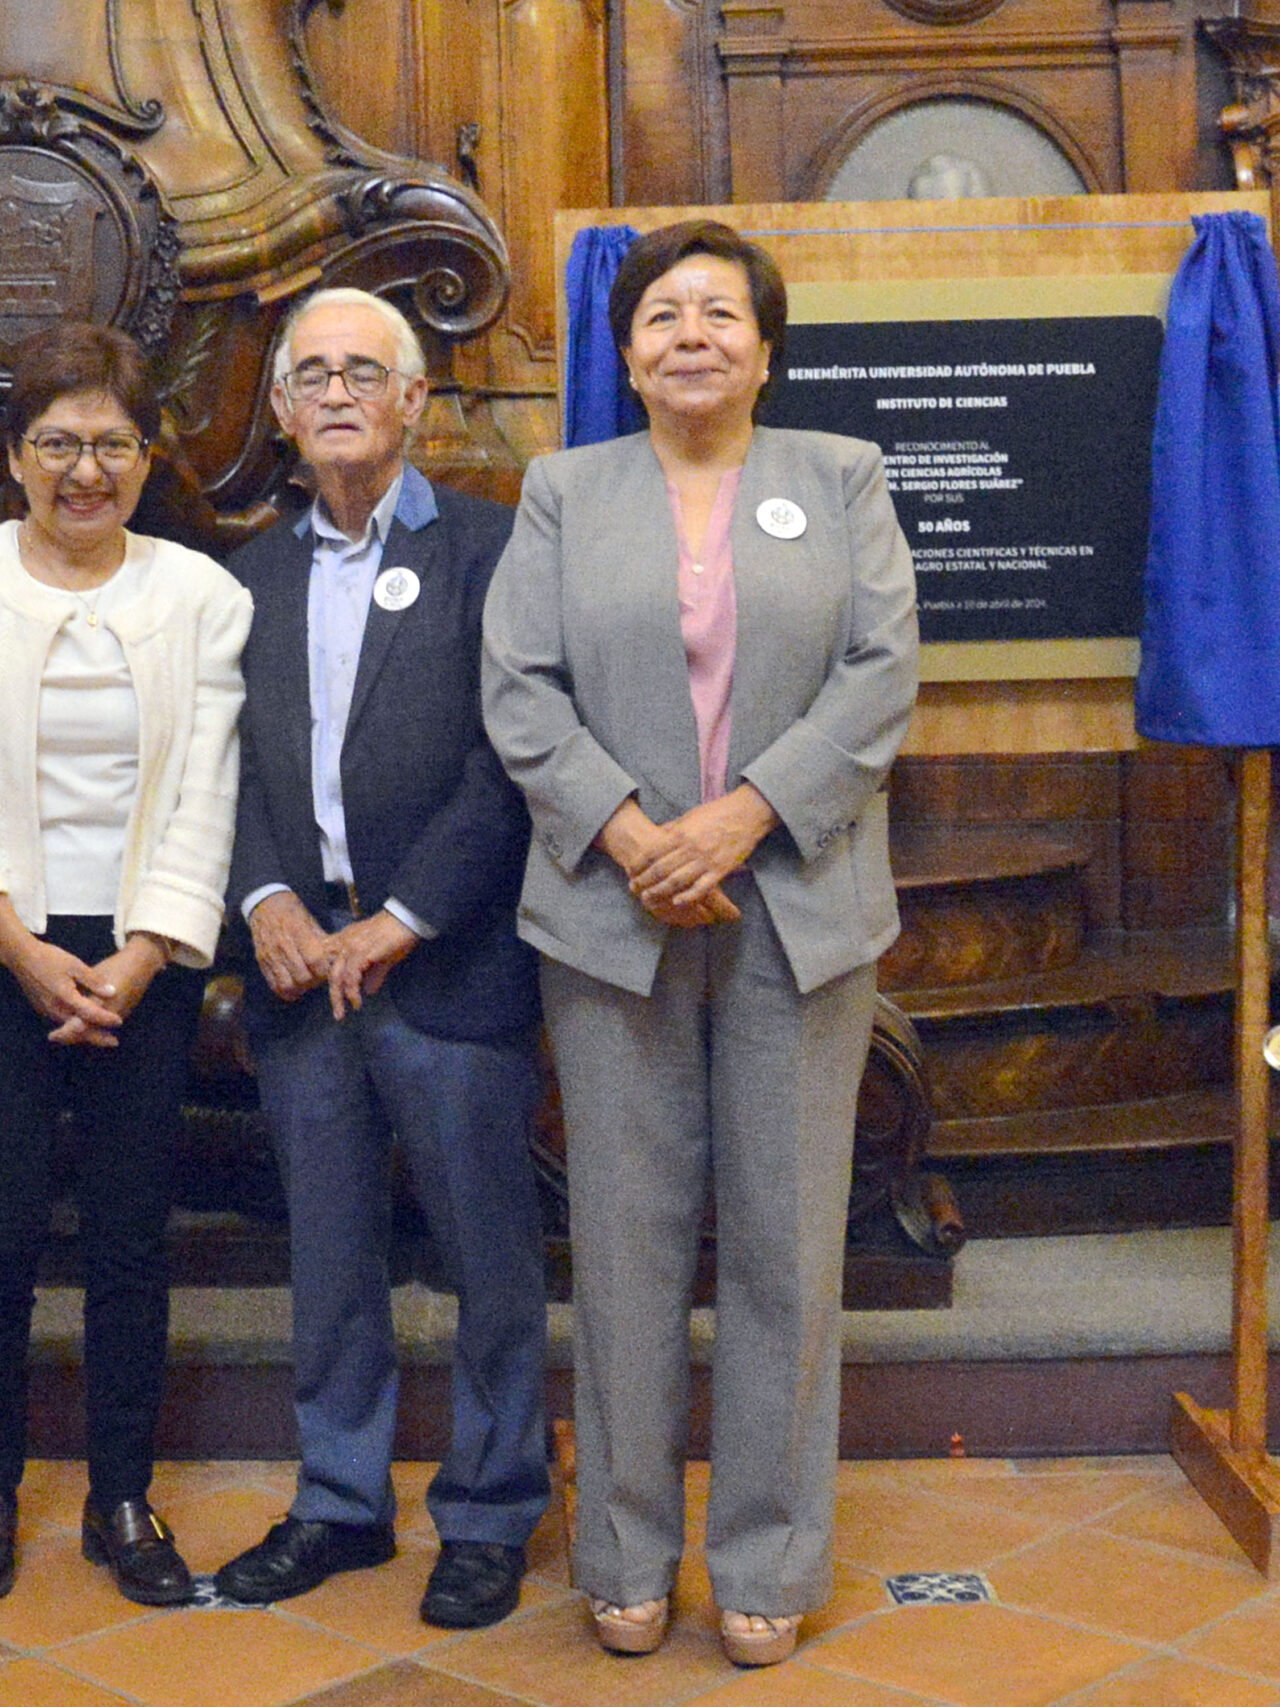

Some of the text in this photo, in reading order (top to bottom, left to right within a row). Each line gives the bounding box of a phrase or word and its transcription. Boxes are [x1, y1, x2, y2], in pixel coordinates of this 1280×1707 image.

[787, 362, 1096, 380] BENEMÉRITA UNIVERSIDAD AUTÓNOMA DE PUEBLA
[876, 396, 1008, 410] INSTITUTO DE CIENCIAS
[895, 441, 991, 452] RECONOCIMIENTO AL
[881, 451, 1009, 465] ENTRO DE INVESTIGACIÓN
[900, 467, 946, 477] CIENCIAS
[947, 465, 1002, 476] AGRÍCOLAS
[901, 480, 939, 490] SERGIO
[940, 479, 978, 490] FLORES
[923, 493, 964, 503] POR SUS
[918, 518, 971, 533] 50 AÑOS
[1019, 547, 1027, 557] Y
[1028, 545, 1078, 557] TÉCNICAS
[1079, 545, 1094, 556] EN
[915, 561, 944, 572] AGRO
[945, 560, 987, 571] ESTATAL
[988, 561, 996, 571] Y
